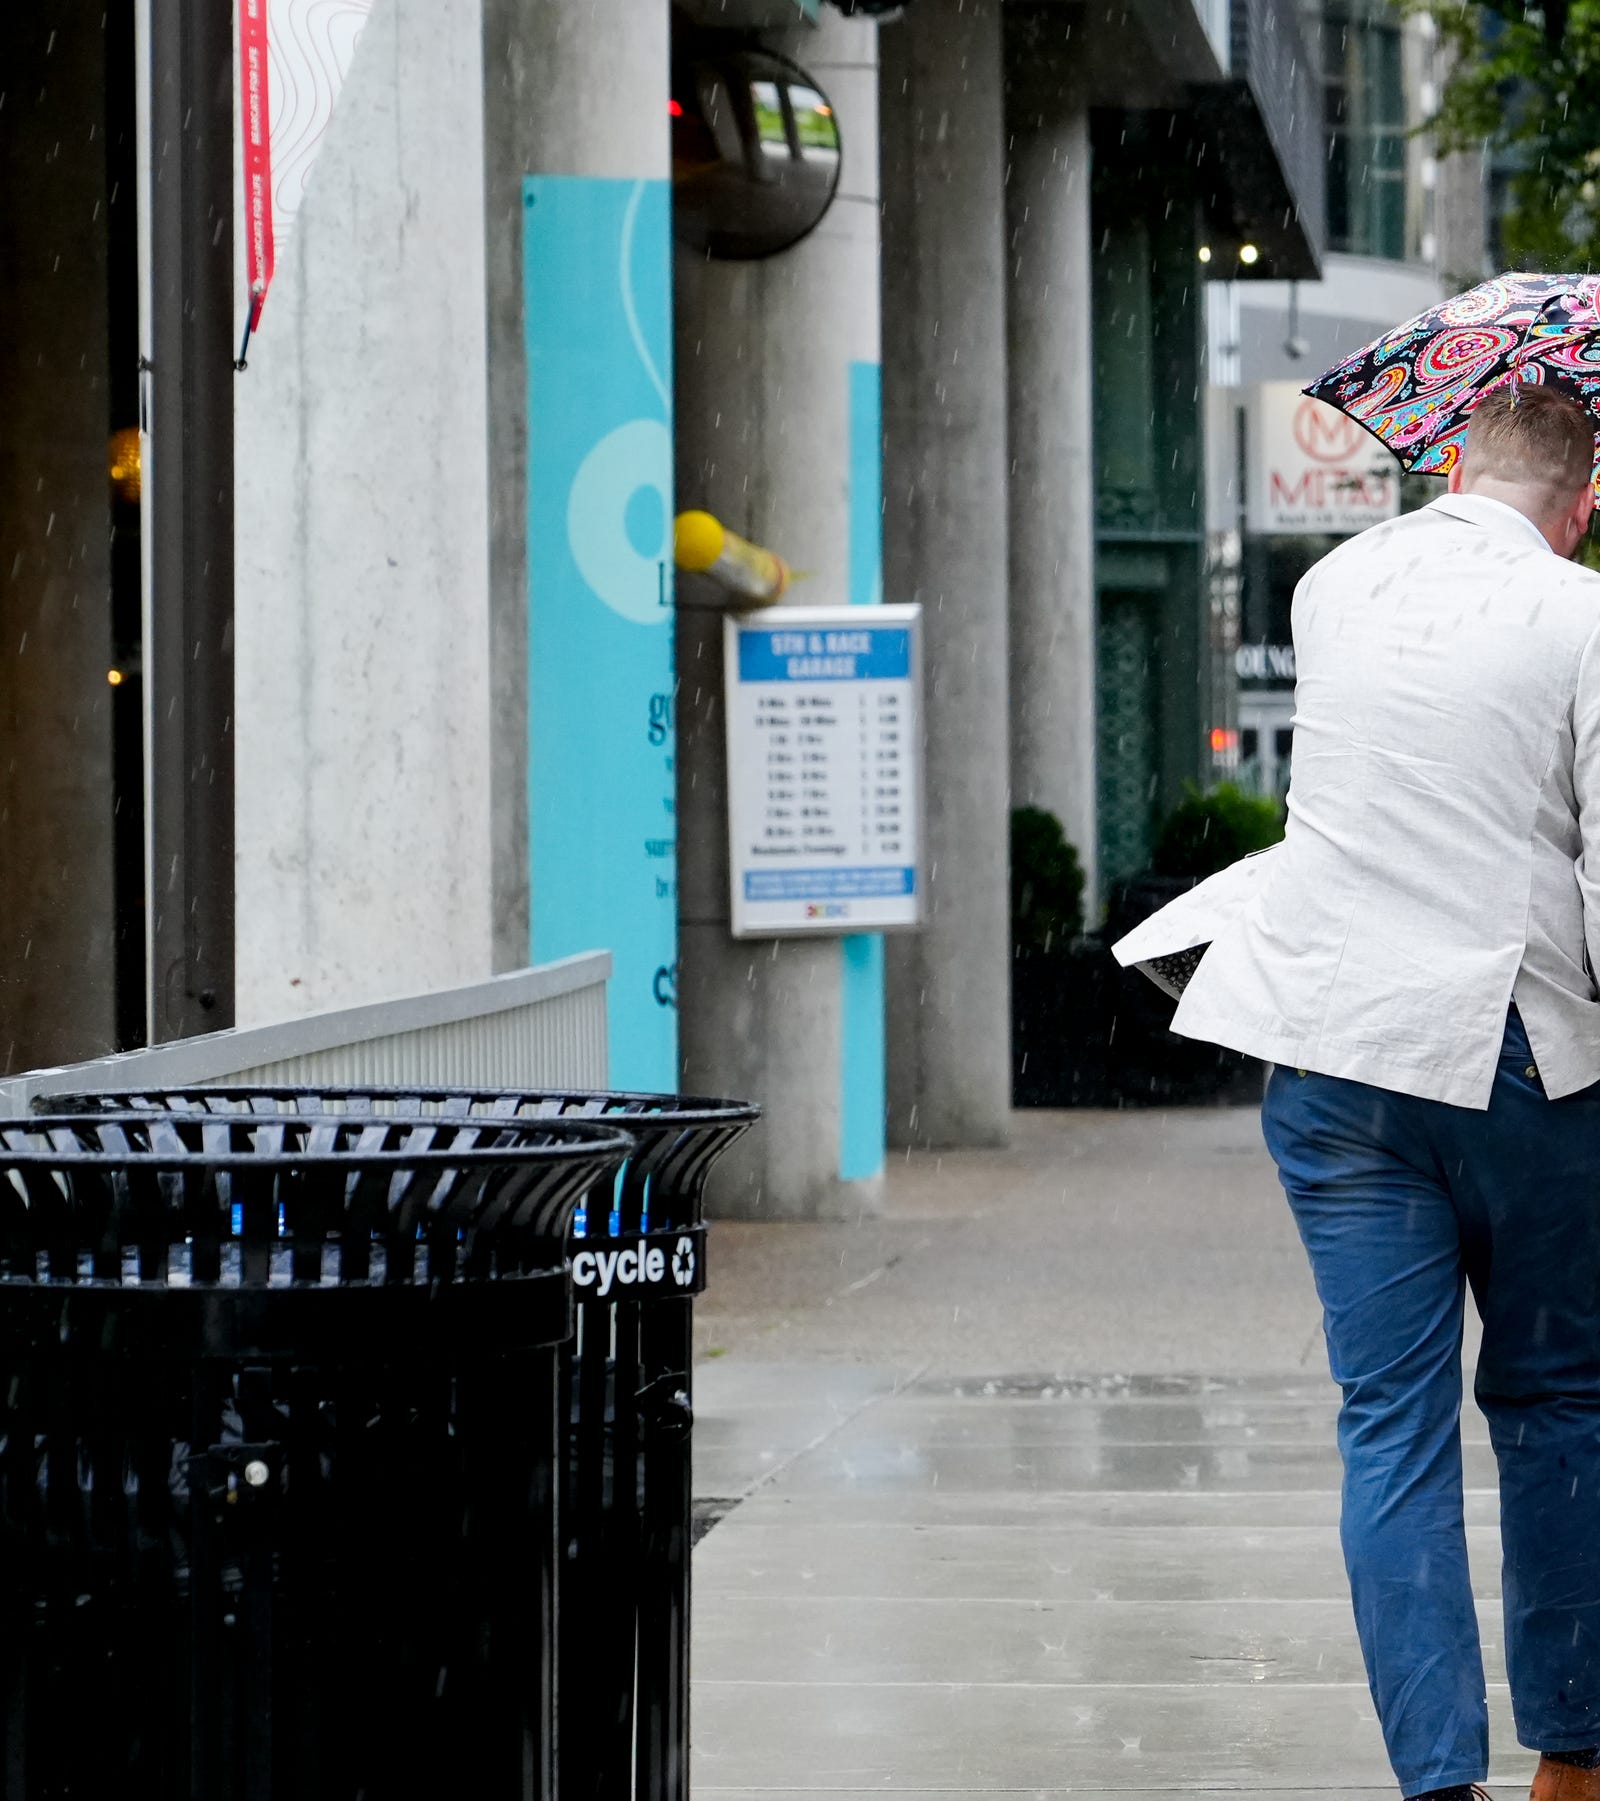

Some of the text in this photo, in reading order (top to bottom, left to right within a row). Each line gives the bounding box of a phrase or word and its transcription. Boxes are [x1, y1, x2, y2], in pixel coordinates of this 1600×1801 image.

[249, 46, 261, 146] BEARCATS FOR LIFE
[252, 173, 262, 196] LIFE
[253, 198, 262, 219] FOR
[825, 631, 871, 654] RACE
[786, 656, 855, 678] GARAGE
